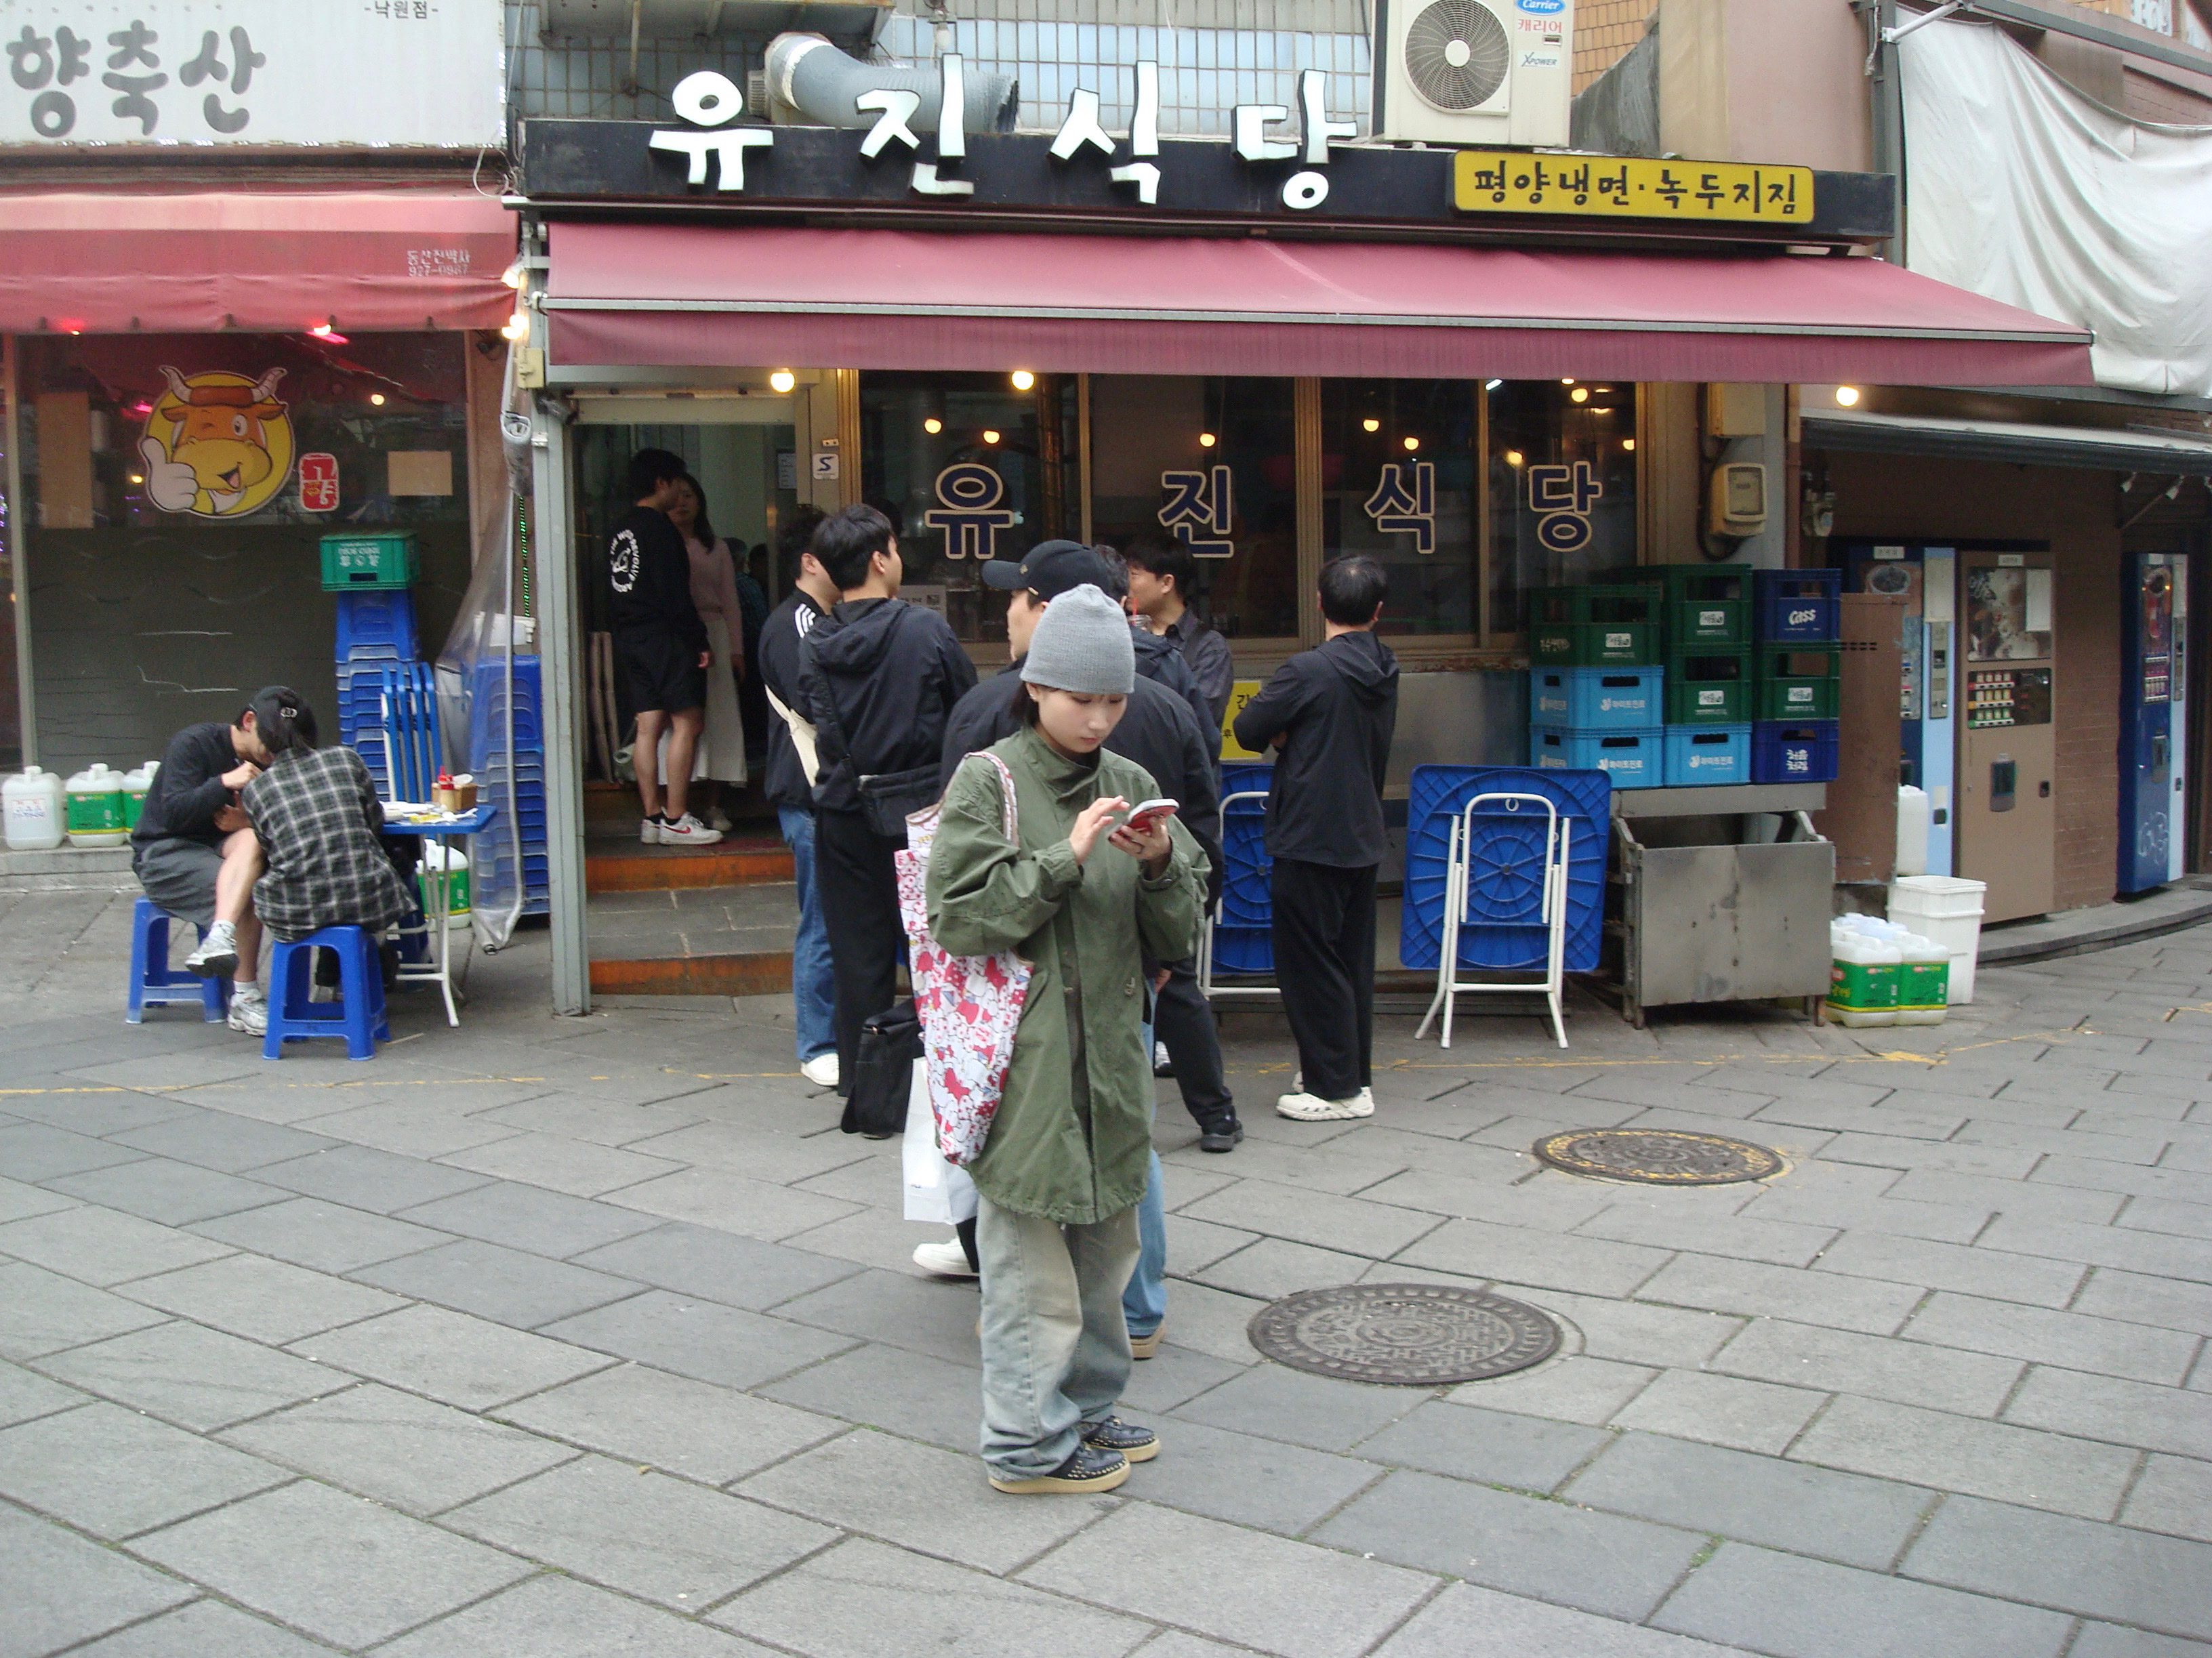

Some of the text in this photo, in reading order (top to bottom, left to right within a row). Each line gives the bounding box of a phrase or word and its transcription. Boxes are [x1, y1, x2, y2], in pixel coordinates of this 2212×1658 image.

[1522, 0, 1560, 9] Carrier
[1518, 19, 1562, 33] 캐리어
[5, 19, 266, 138] 향축산
[649, 53, 1357, 210] 유진식당
[1788, 609, 1817, 625] Cass
